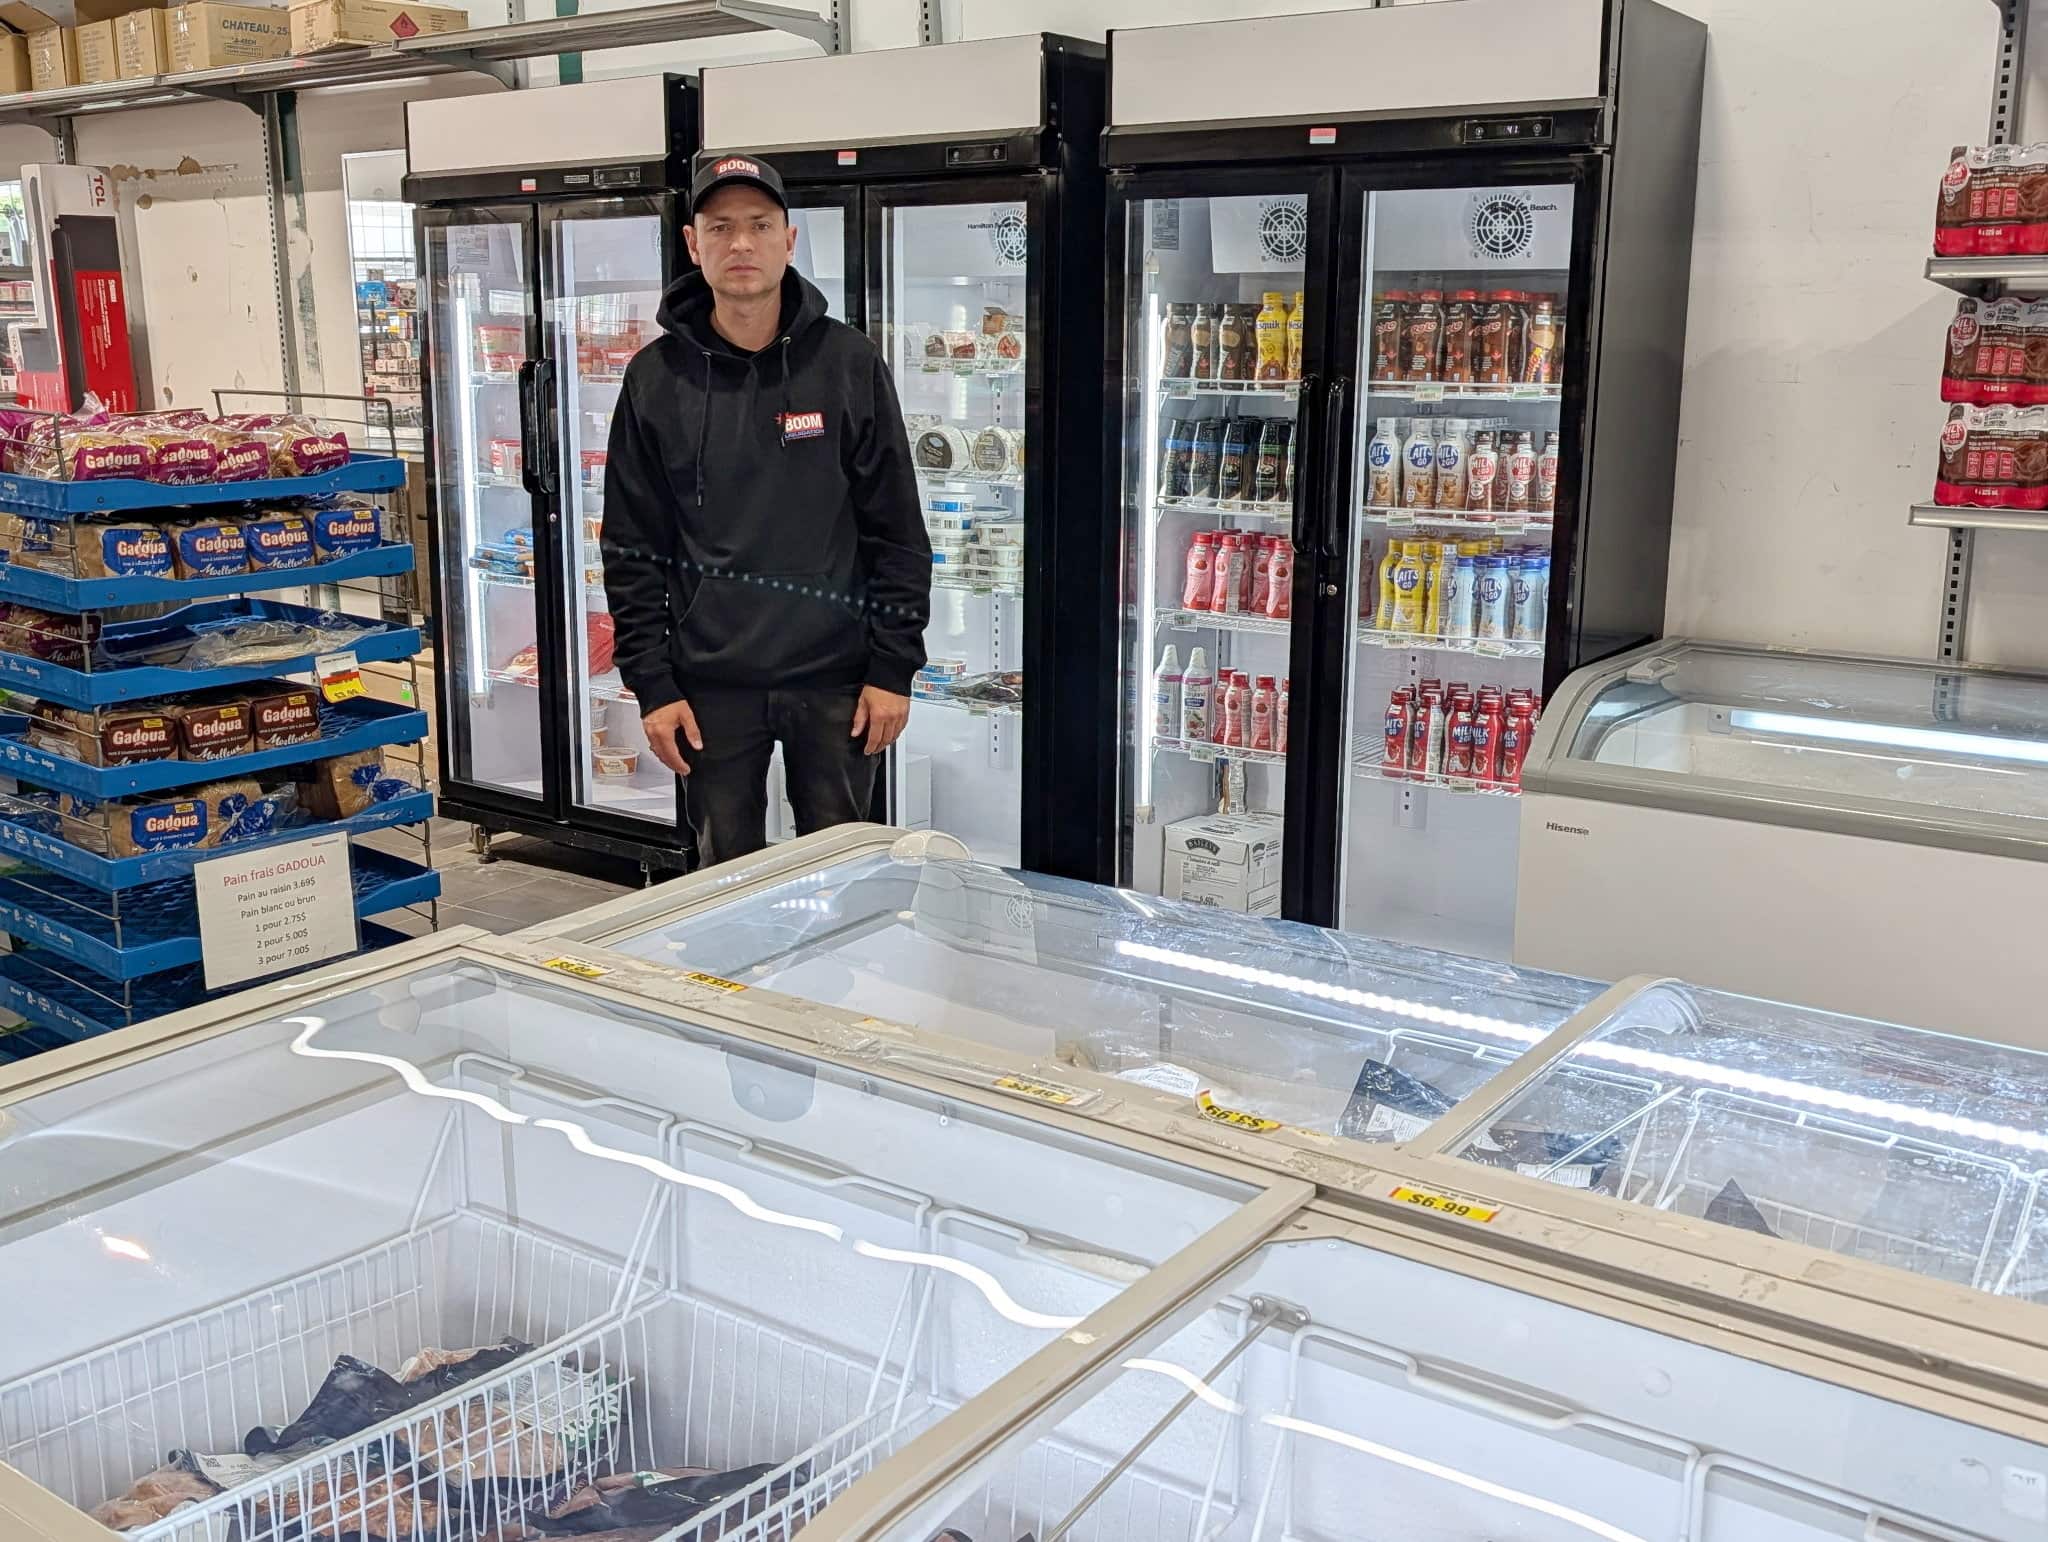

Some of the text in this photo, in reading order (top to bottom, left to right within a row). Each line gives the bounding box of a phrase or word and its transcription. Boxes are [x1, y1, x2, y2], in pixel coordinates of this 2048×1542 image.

[222, 19, 270, 34] CHATEAU
[719, 160, 760, 174] BOOM
[93, 174, 106, 208] TCL
[785, 413, 824, 432] BOOM
[85, 451, 141, 469] Gadoua
[216, 449, 261, 470] adoua
[328, 520, 375, 536] Gadoua
[118, 538, 167, 557] Gadoua
[195, 536, 245, 553] Gadoua
[260, 530, 309, 547] Gadoua
[262, 706, 312, 723] Gadoua
[112, 728, 167, 745] Gadoua
[193, 718, 243, 737] Gadoua
[145, 815, 199, 832] Gadoua
[1546, 821, 1590, 836] Hisense
[223, 855, 326, 887] Pain frais GADOUA
[237, 876, 316, 903] Pain au raisin 3.69$
[240, 909, 259, 920] Pain
[261, 902, 283, 914] blanc
[297, 894, 316, 906] brun
[262, 919, 282, 932] pour
[284, 912, 307, 925] 2.75$
[257, 940, 262, 949] 2
[264, 936, 284, 949] pour
[257, 944, 310, 965] 3 pour 7.00$
[1206, 1105, 1264, 1127] $3.99
[1407, 1193, 1471, 1217] $6.99
